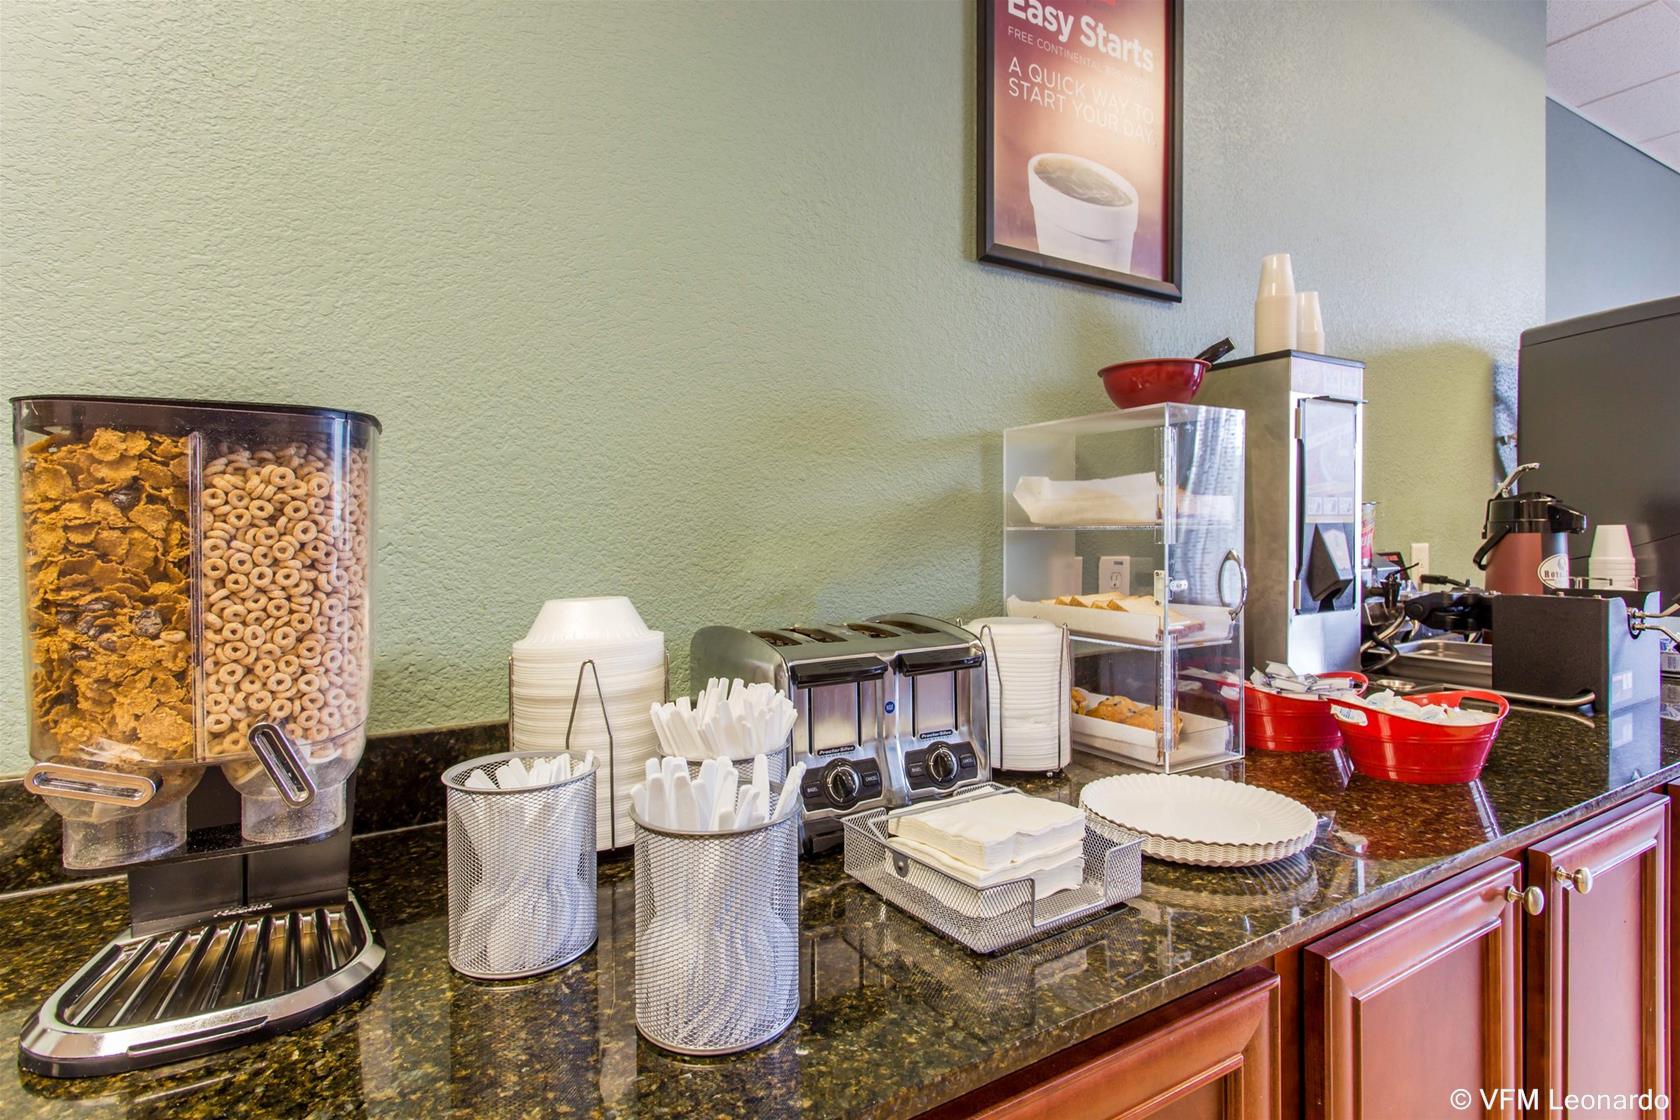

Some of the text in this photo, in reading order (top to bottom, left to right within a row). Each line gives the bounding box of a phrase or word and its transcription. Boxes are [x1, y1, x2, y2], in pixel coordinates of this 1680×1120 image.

[1008, 26, 1034, 45] FREE
[1008, 0, 1154, 72] Easy Starts
[1009, 56, 1022, 77] A
[1028, 64, 1086, 99] QUICK
[1093, 87, 1131, 115] WAY
[1135, 103, 1154, 124] TO
[1009, 77, 1066, 113] START
[1073, 100, 1121, 132] YOUR
